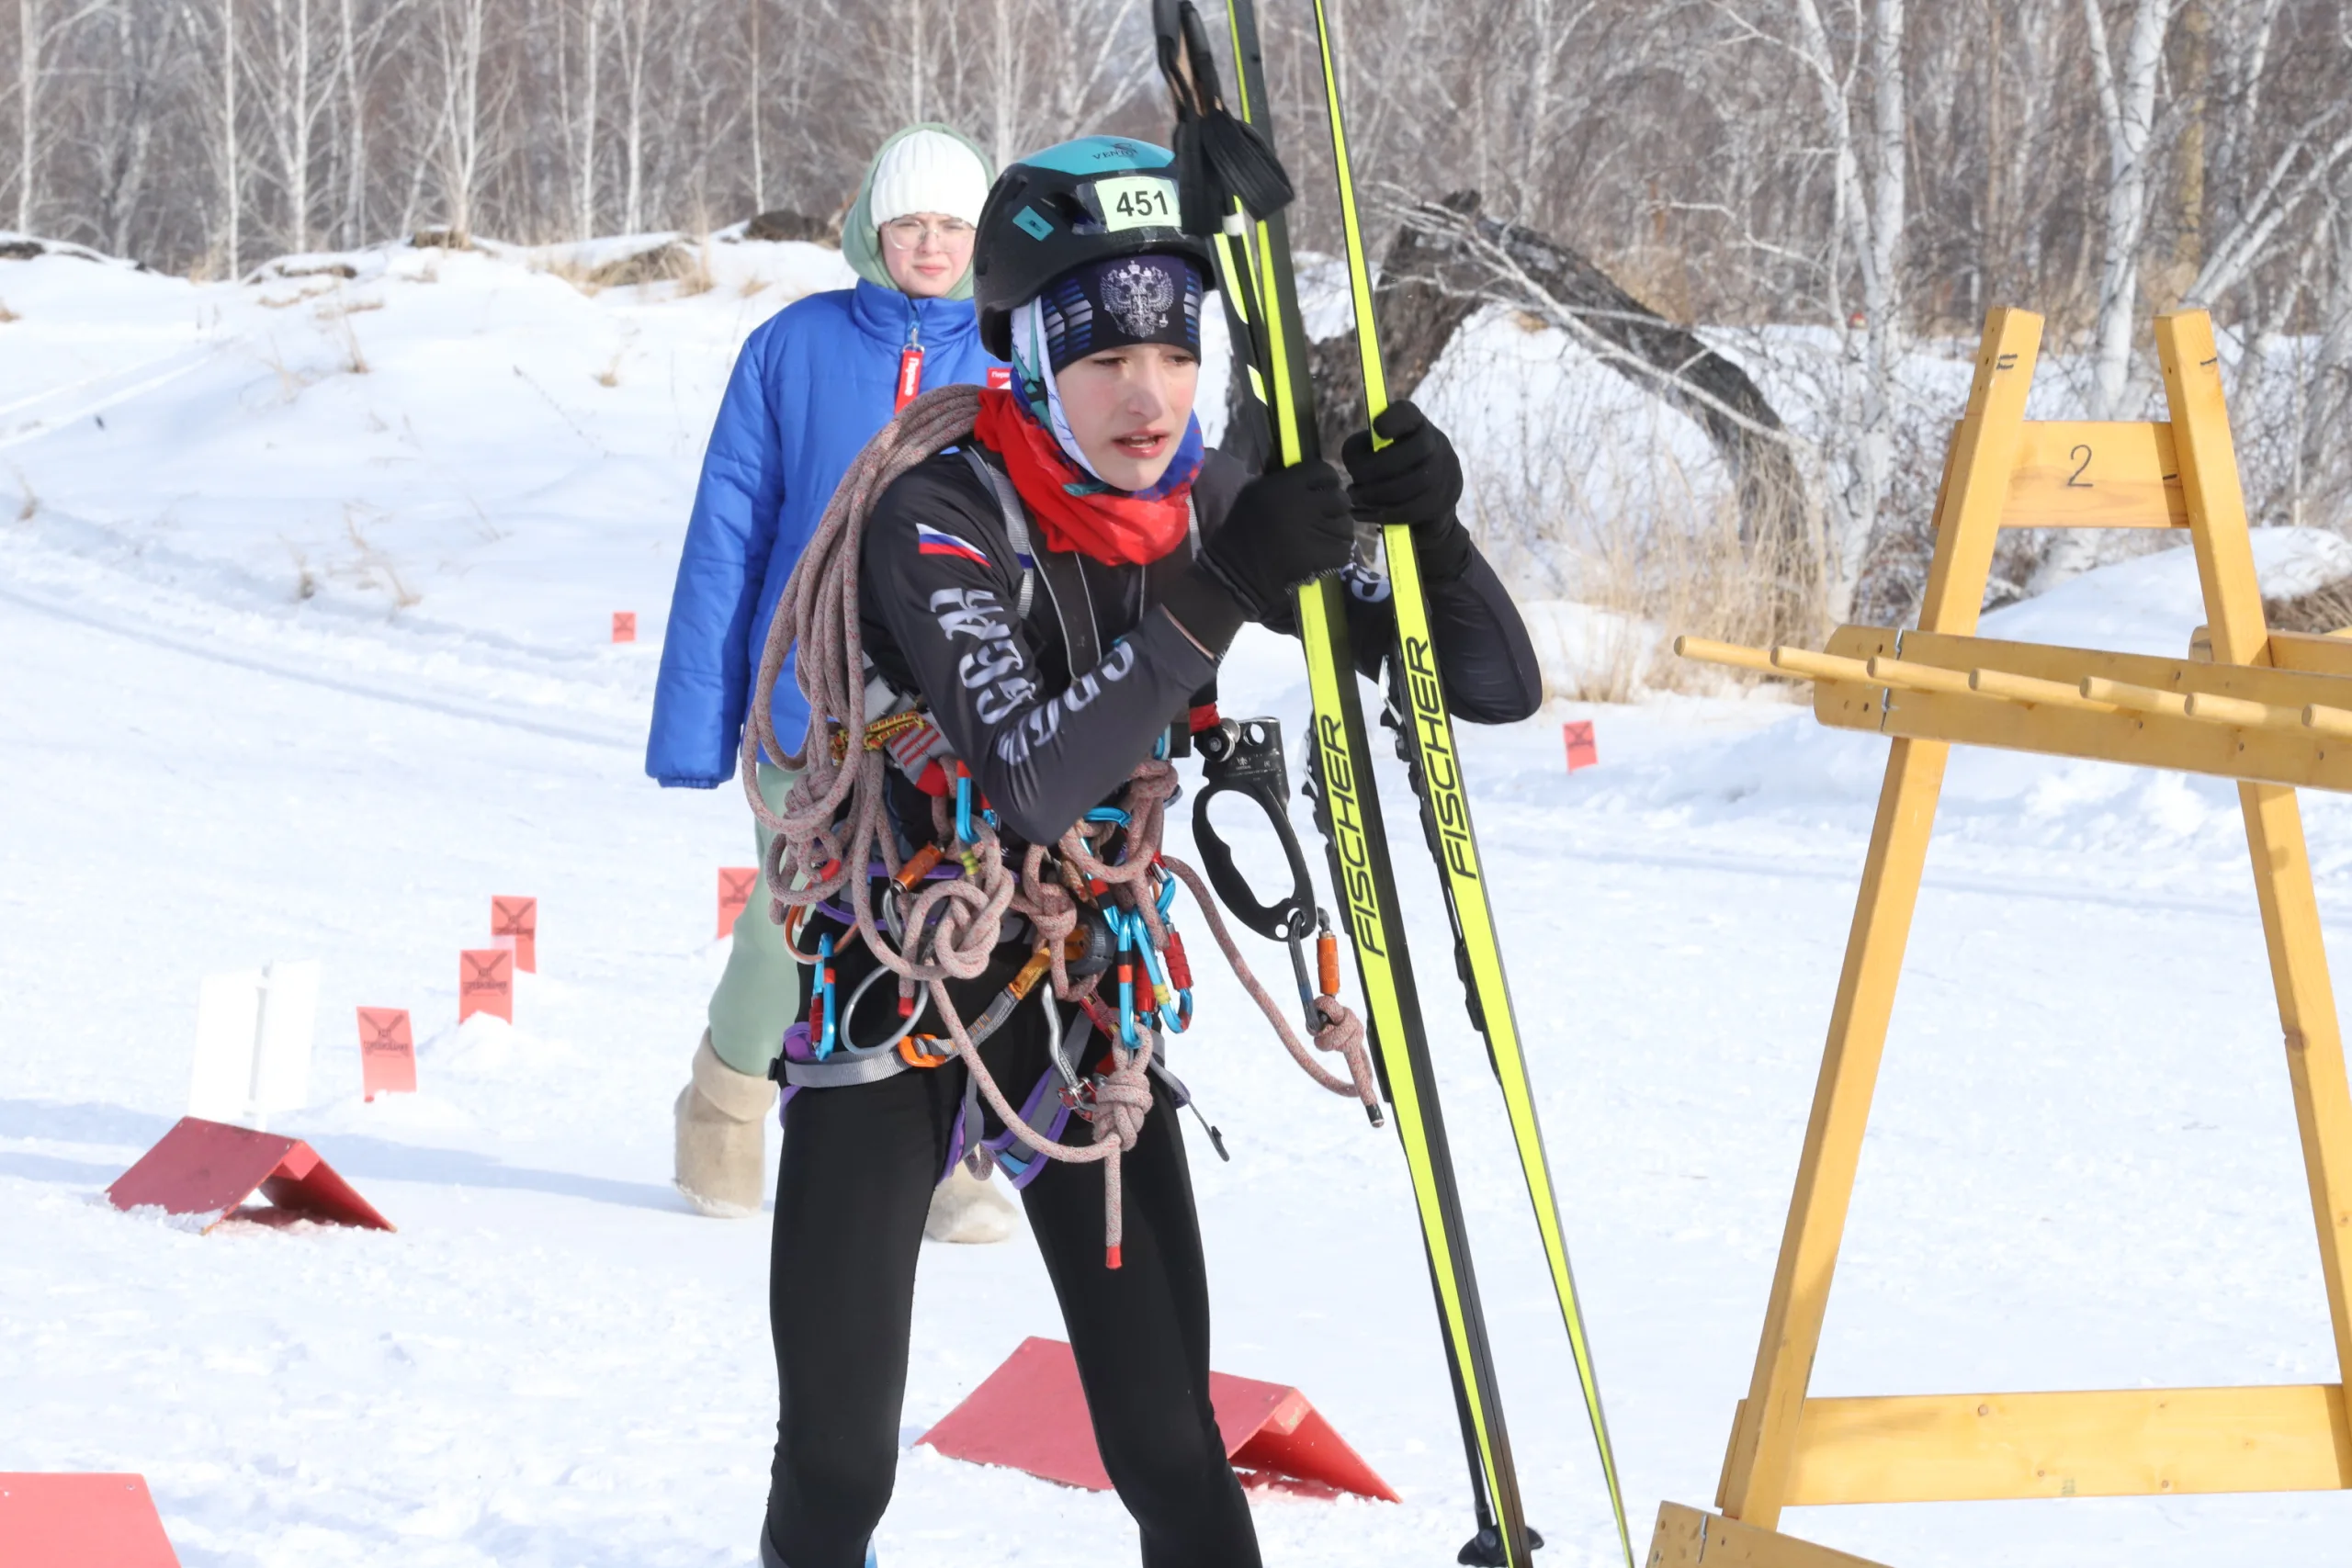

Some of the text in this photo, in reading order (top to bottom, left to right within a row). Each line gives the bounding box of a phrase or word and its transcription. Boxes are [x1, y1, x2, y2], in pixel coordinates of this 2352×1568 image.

[1116, 190, 1168, 217] 451
[2067, 444, 2094, 488] 2
[1406, 636, 1477, 880] FISCHER
[1320, 714, 1385, 958] FISCHER
